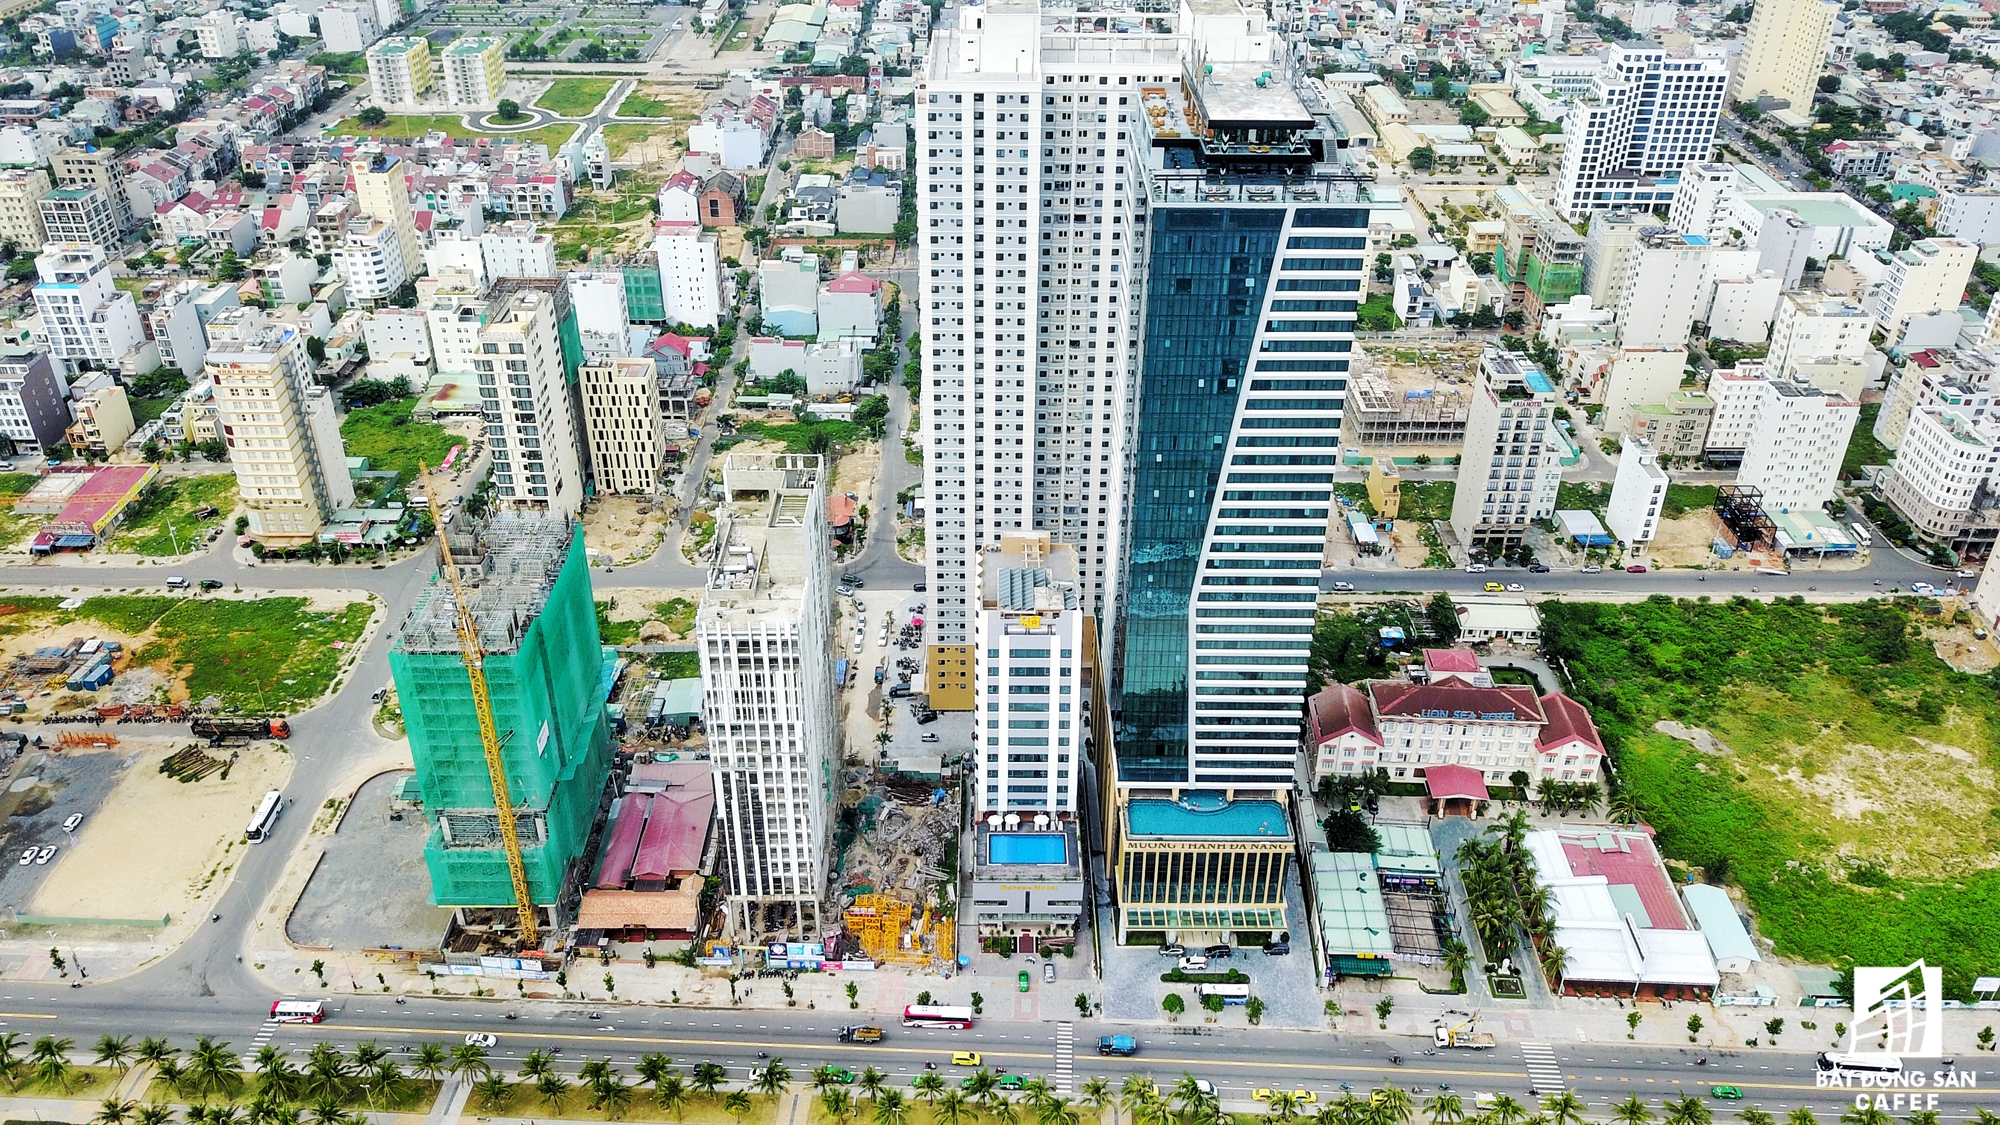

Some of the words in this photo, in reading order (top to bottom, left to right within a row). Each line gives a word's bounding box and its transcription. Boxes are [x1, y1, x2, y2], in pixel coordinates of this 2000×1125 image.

[479, 332, 524, 342] CICILIA
[1421, 709, 1449, 719] LION
[1453, 710, 1476, 720] SEA
[1481, 712, 1517, 721] HOTEL
